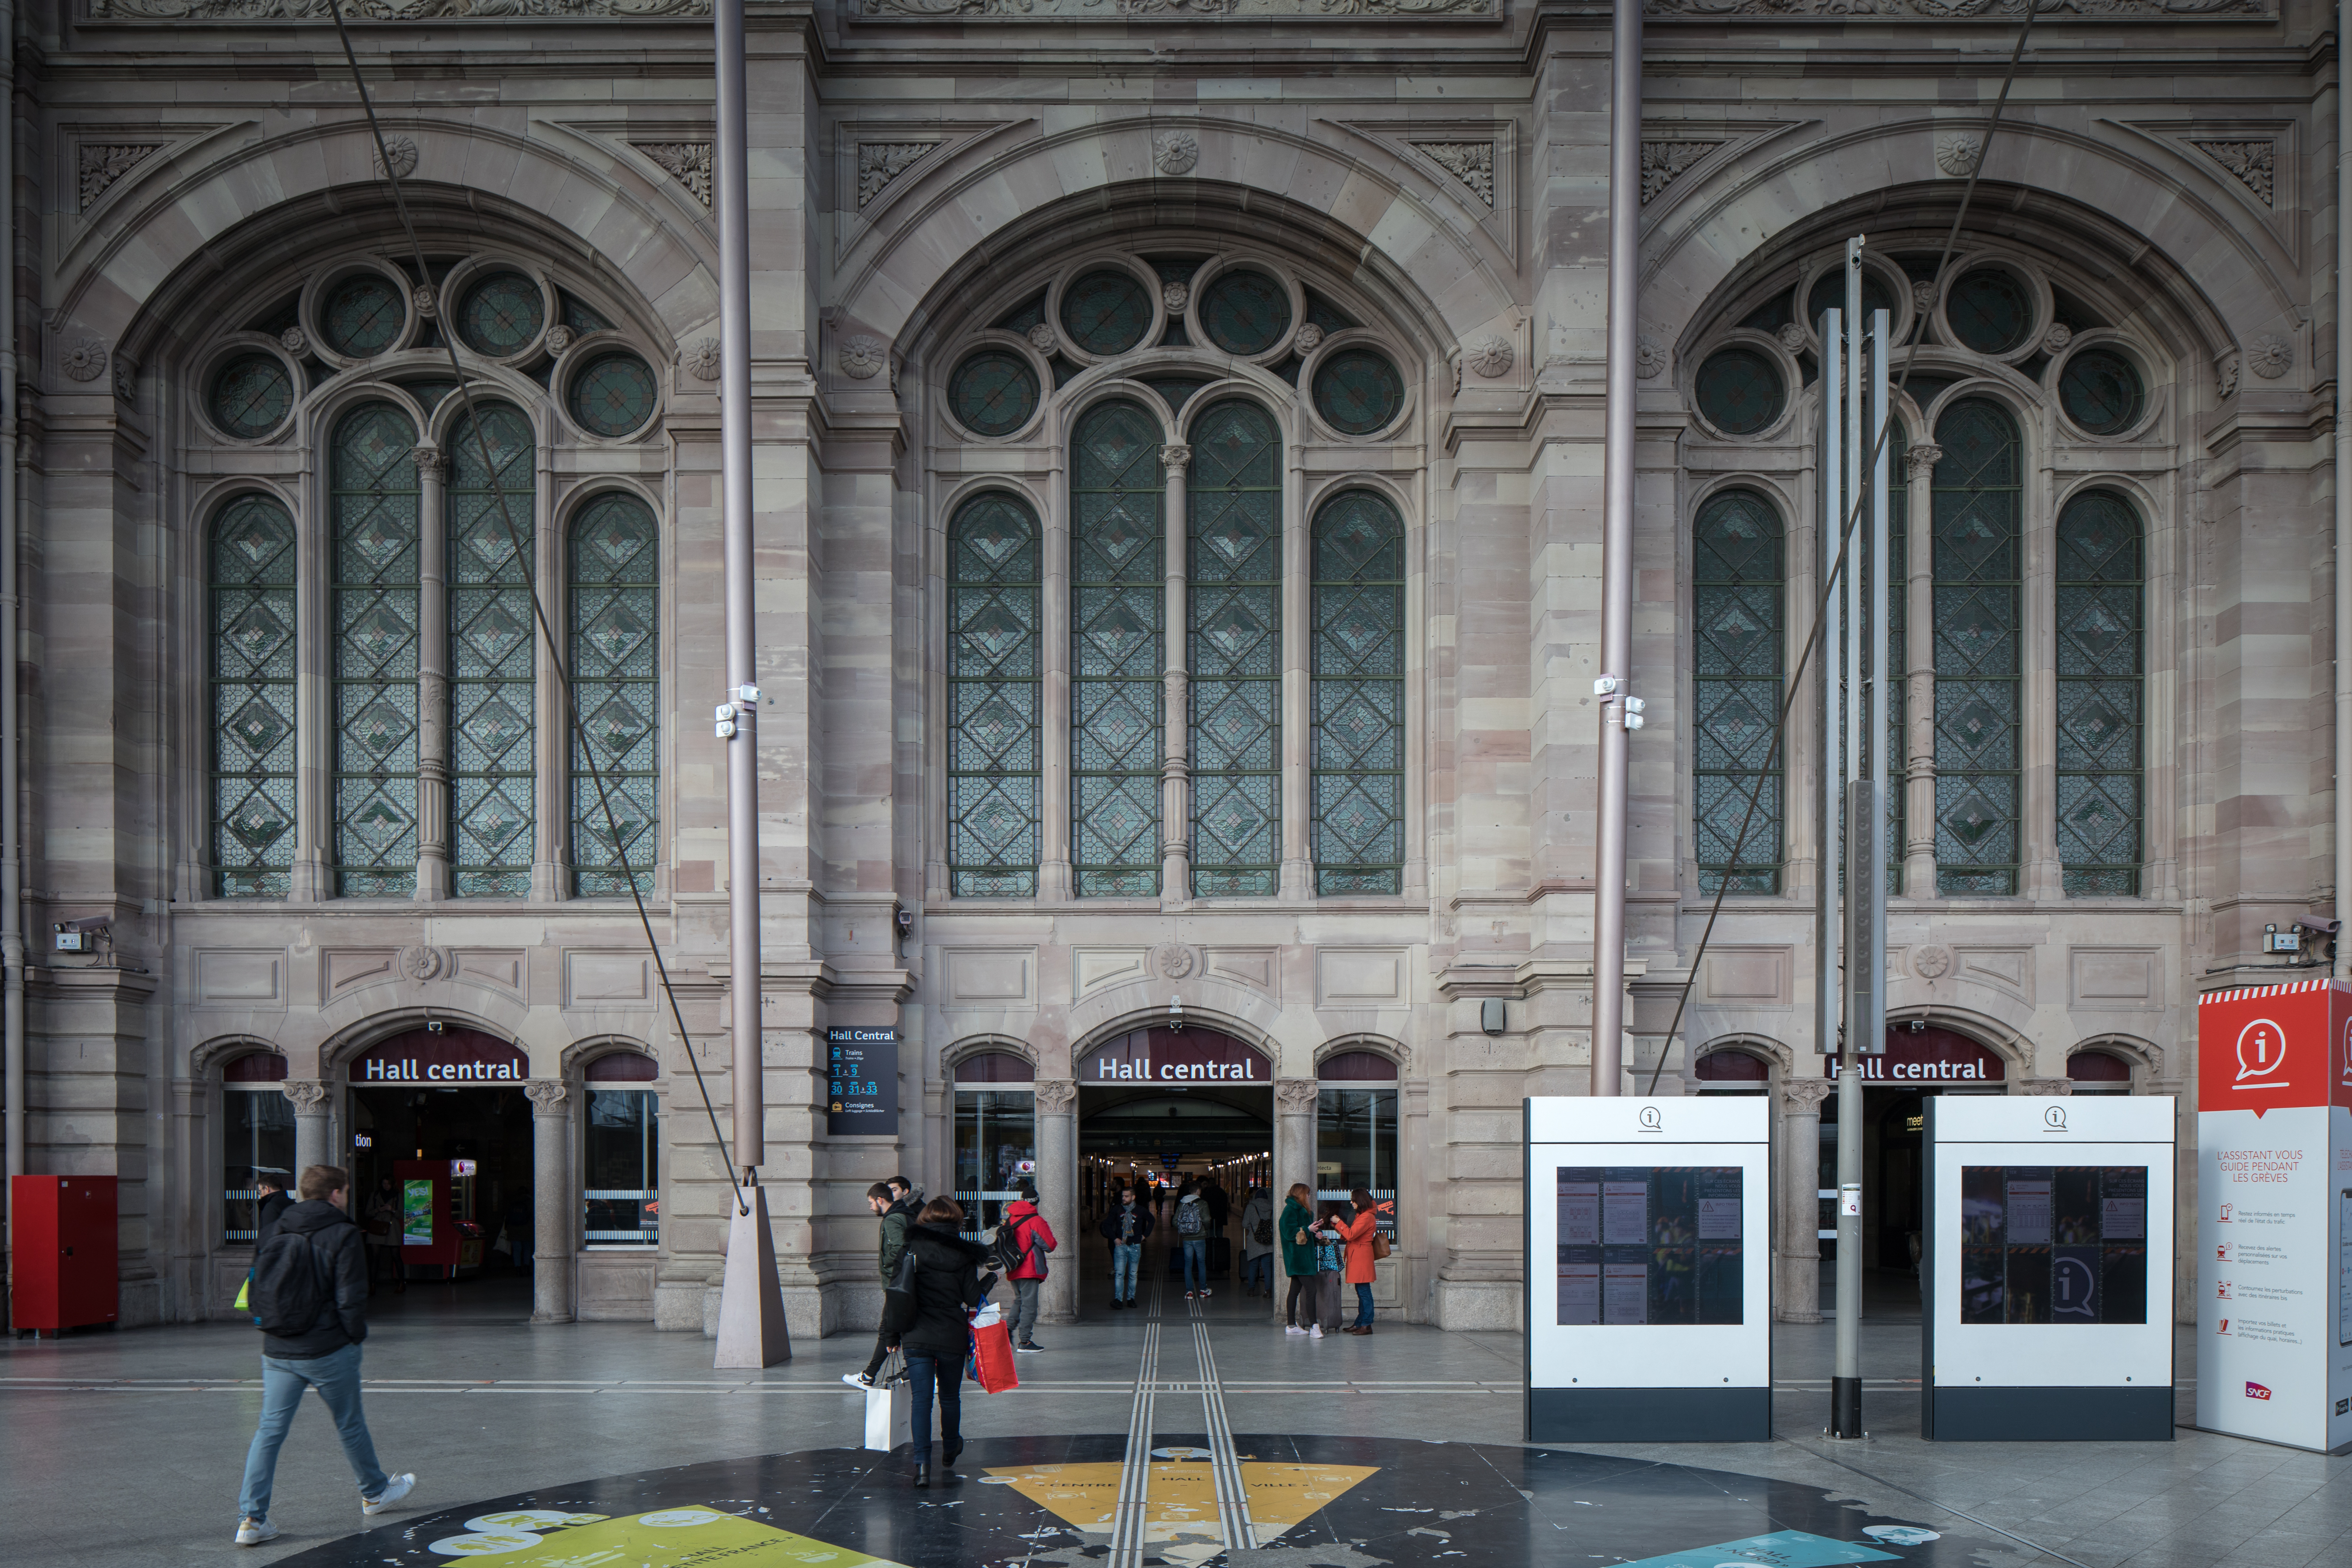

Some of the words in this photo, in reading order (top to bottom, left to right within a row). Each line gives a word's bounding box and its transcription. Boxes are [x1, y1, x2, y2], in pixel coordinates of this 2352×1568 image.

[830, 1031, 852, 1040] Hall
[855, 1031, 894, 1040] Central
[366, 1059, 419, 1079] Hall
[427, 1059, 521, 1079] central
[1099, 1059, 1152, 1079] Hall
[1160, 1059, 1254, 1079] central
[1893, 1058, 1986, 1078] central
[1907, 1114, 1923, 1126] meet
[355, 1134, 371, 1147] tion
[2217, 1151, 2273, 1160] L'ASSISTANT
[2275, 1150, 2303, 1159] VOUS
[2340, 1148, 2352, 1158] TÉLÉCH
[2220, 1162, 2249, 1171] GUIDE
[2252, 1162, 2299, 1170] PENDANT
[2233, 1173, 2248, 1182] LES
[2251, 1172, 2288, 1182] GRÈVES
[407, 1186, 429, 1198] YES!
[2247, 1388, 2270, 1398] SNCF
[680, 1547, 729, 1558] HALL
[718, 1538, 786, 1557] FRANCE
[1746, 1547, 1792, 1560] HALL
[1724, 1549, 1780, 1564] NORD
